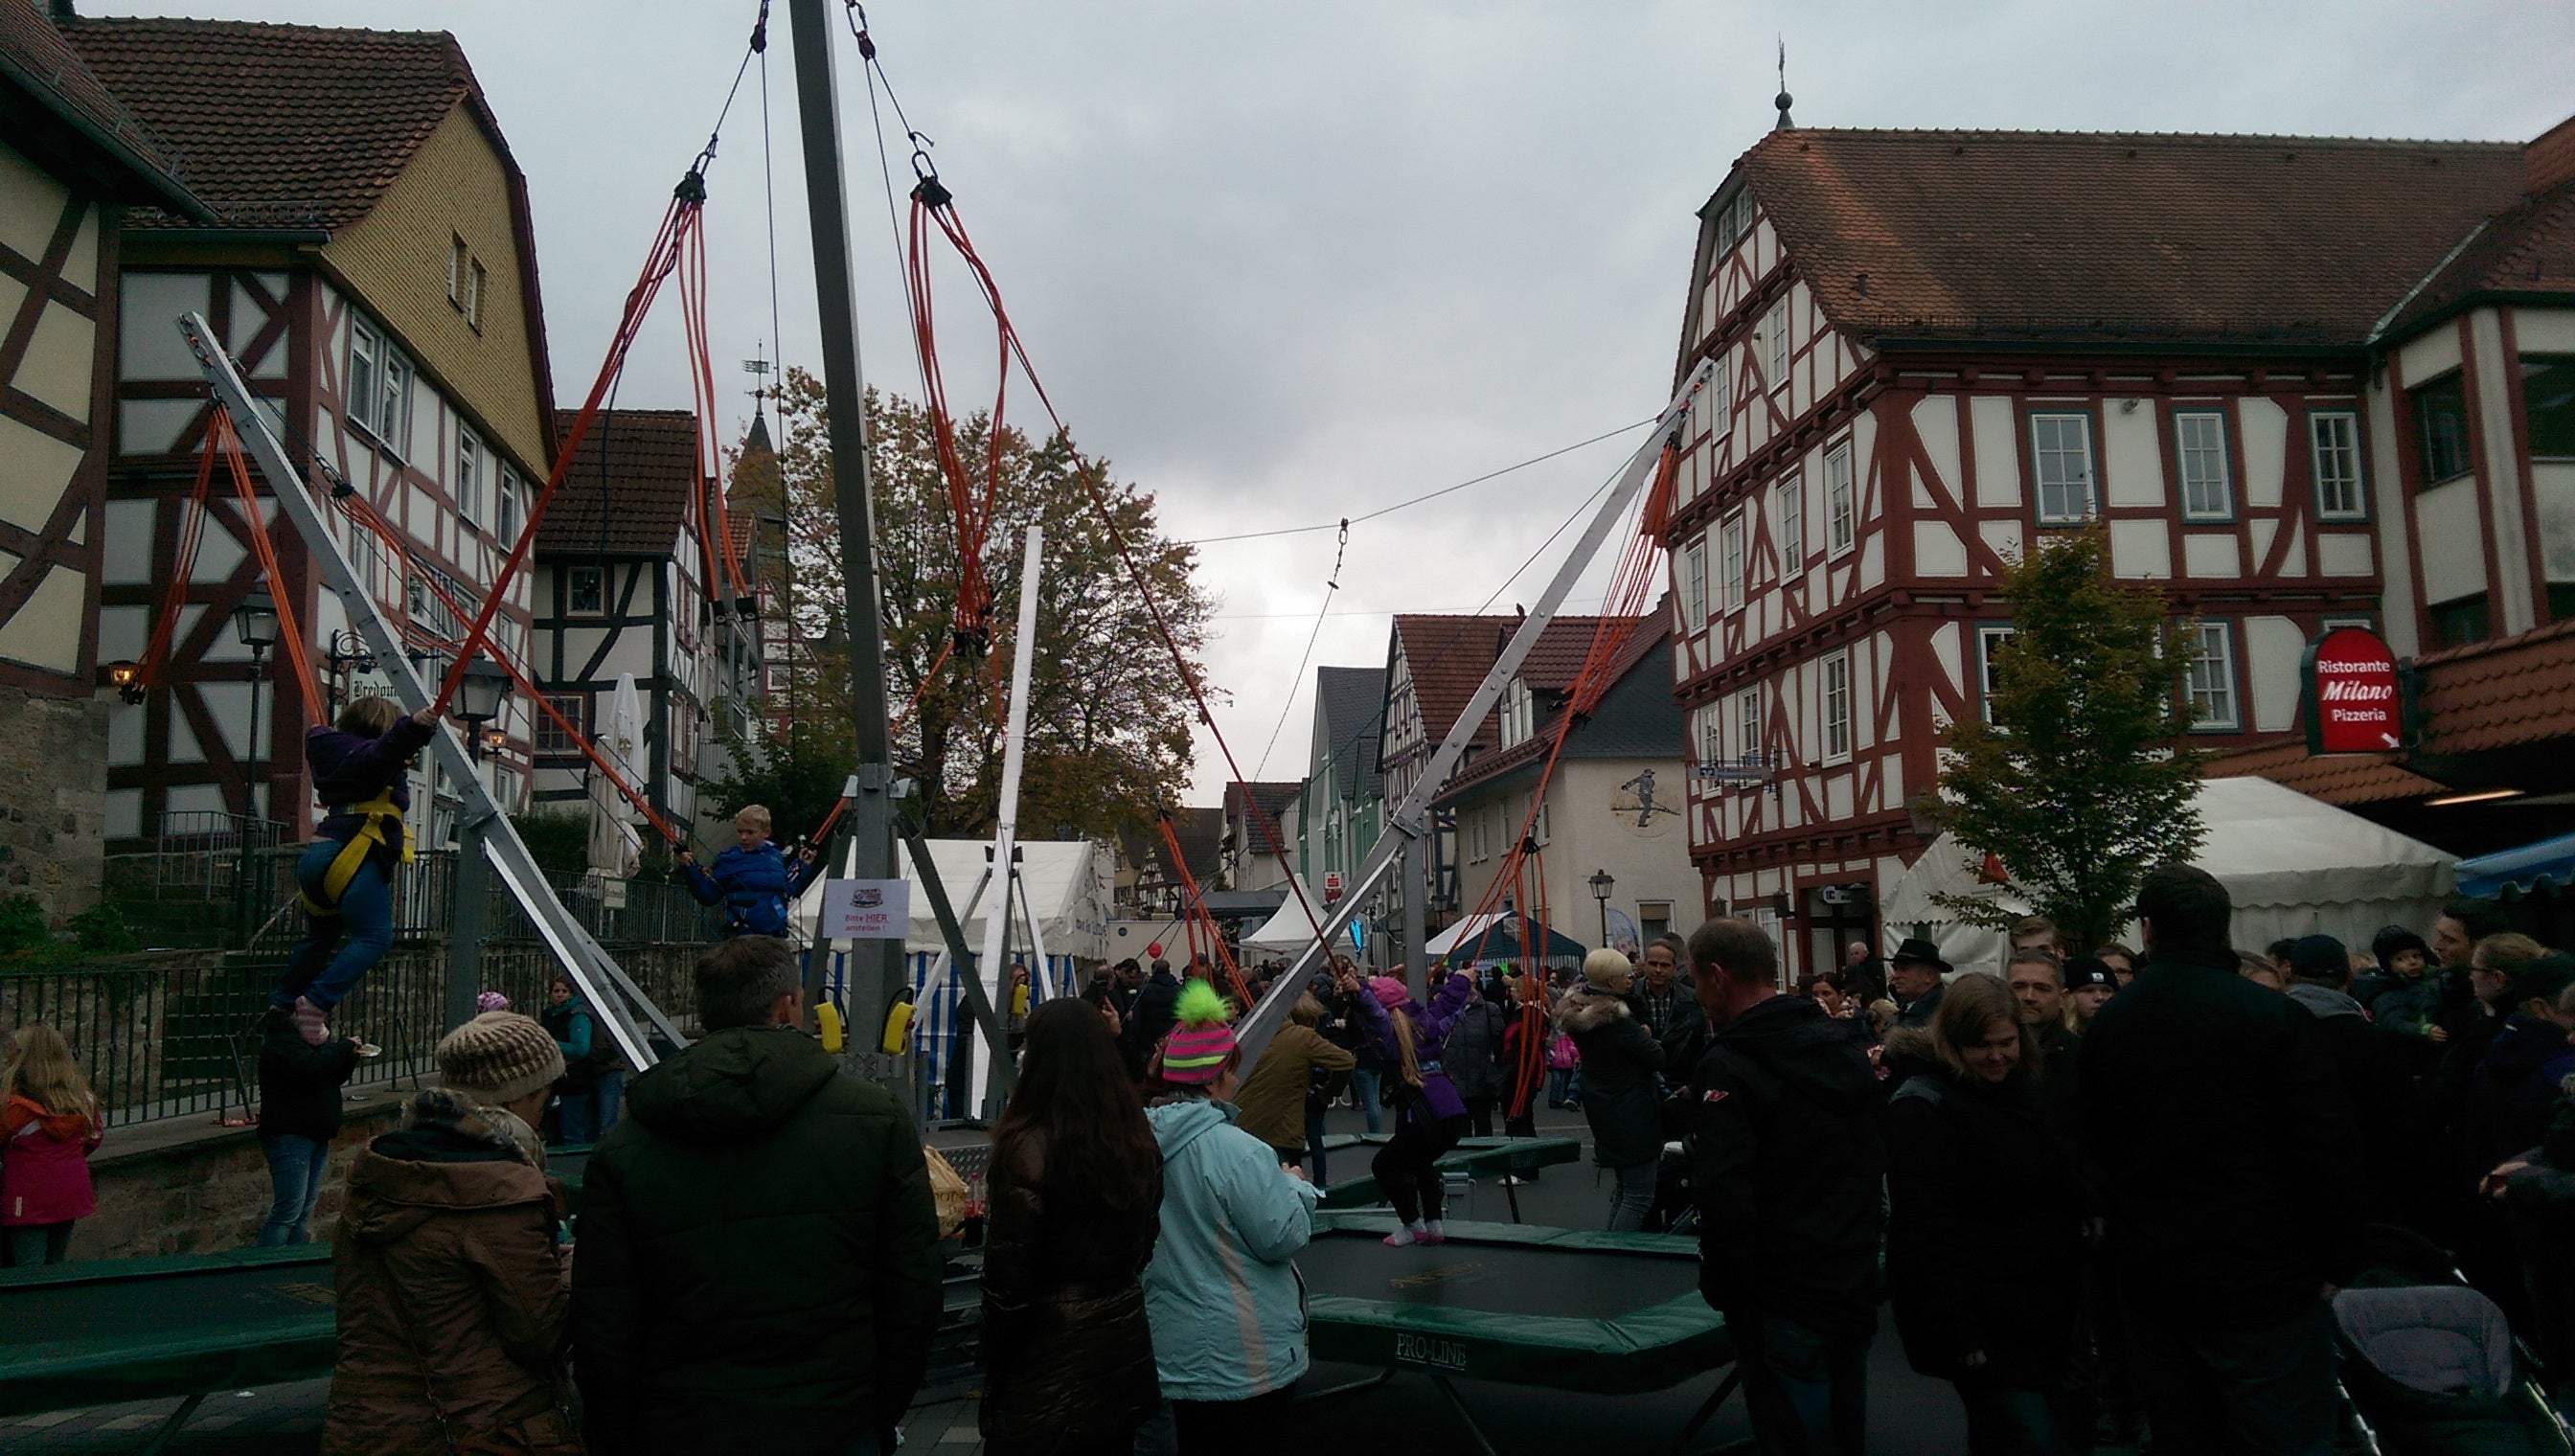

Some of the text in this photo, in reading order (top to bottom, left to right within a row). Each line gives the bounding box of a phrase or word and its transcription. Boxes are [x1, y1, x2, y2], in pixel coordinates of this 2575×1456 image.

[2316, 660, 2391, 673] Ristorante
[2321, 680, 2393, 701] Milano
[2331, 708, 2387, 722] Pizzeria
[865, 913, 888, 922] HIER
[1396, 1332, 1467, 1367] PRO-LINE
